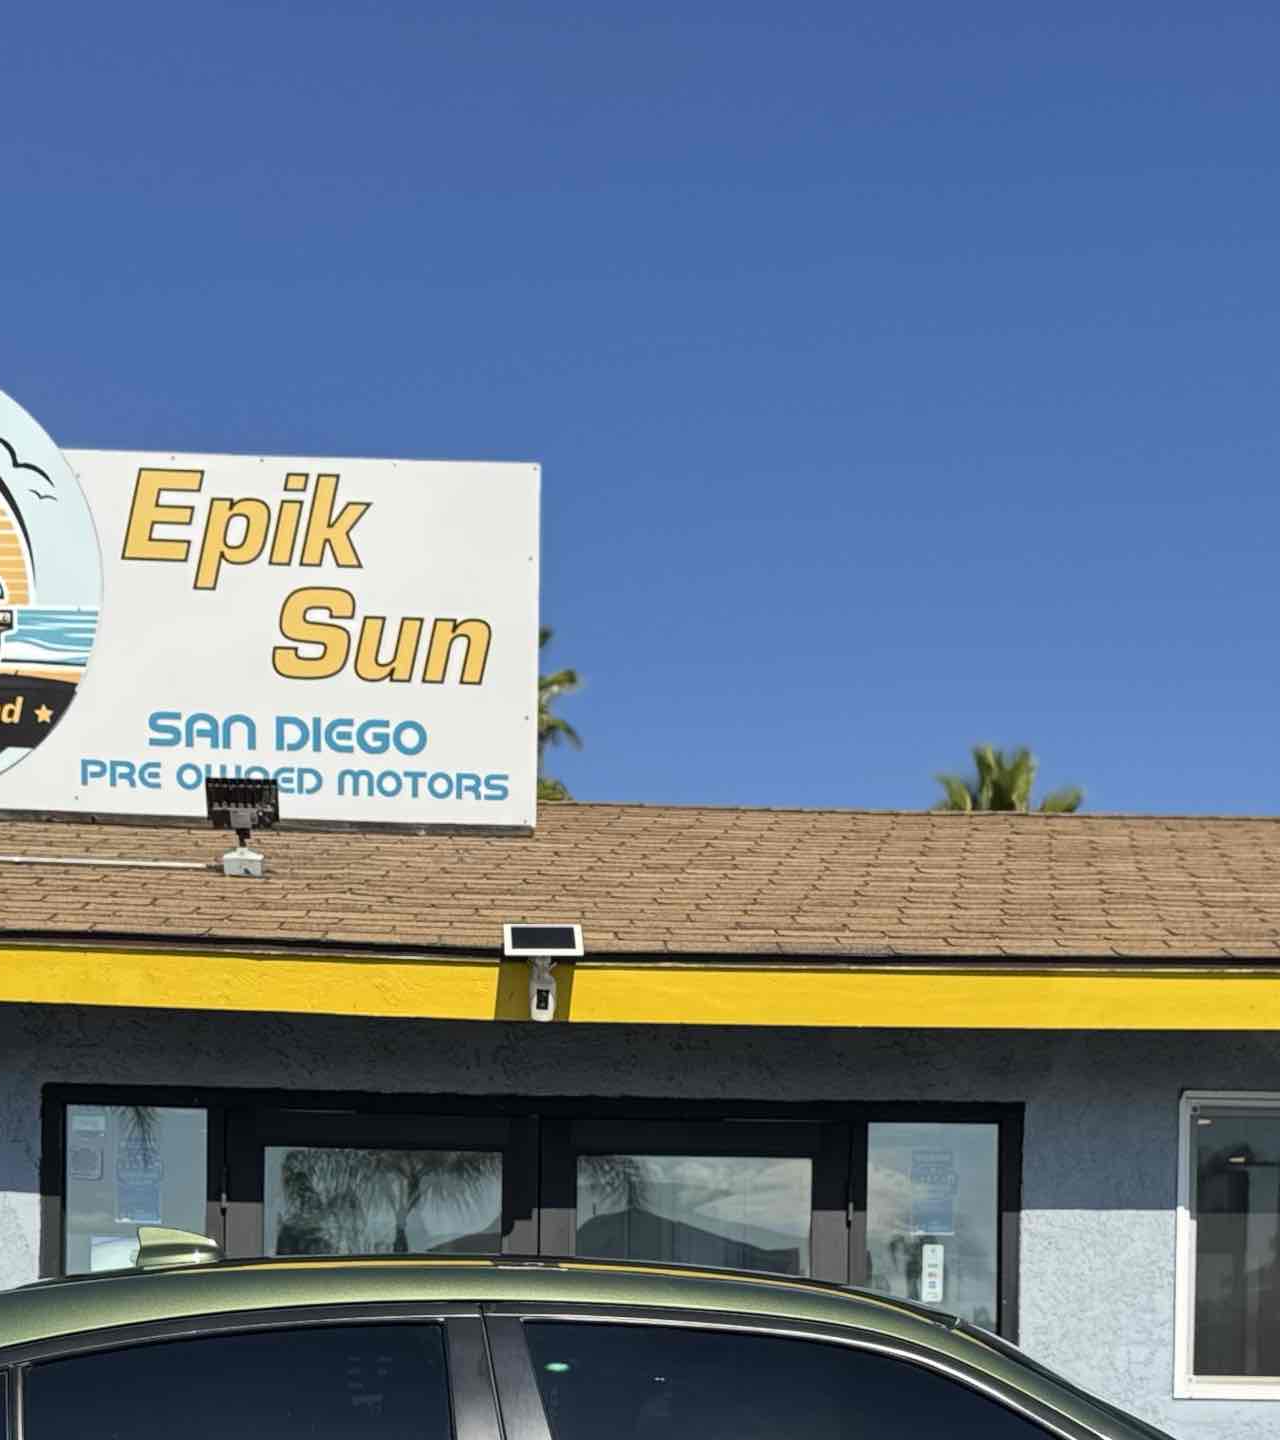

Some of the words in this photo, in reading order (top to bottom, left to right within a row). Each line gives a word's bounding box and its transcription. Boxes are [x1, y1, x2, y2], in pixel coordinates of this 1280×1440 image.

[120, 467, 374, 591] Epik
[271, 585, 493, 686] Sun
[147, 710, 257, 751] SAN
[274, 714, 429, 757] DIEGO
[79, 758, 162, 790] PRE
[336, 768, 511, 802] MOTORS
